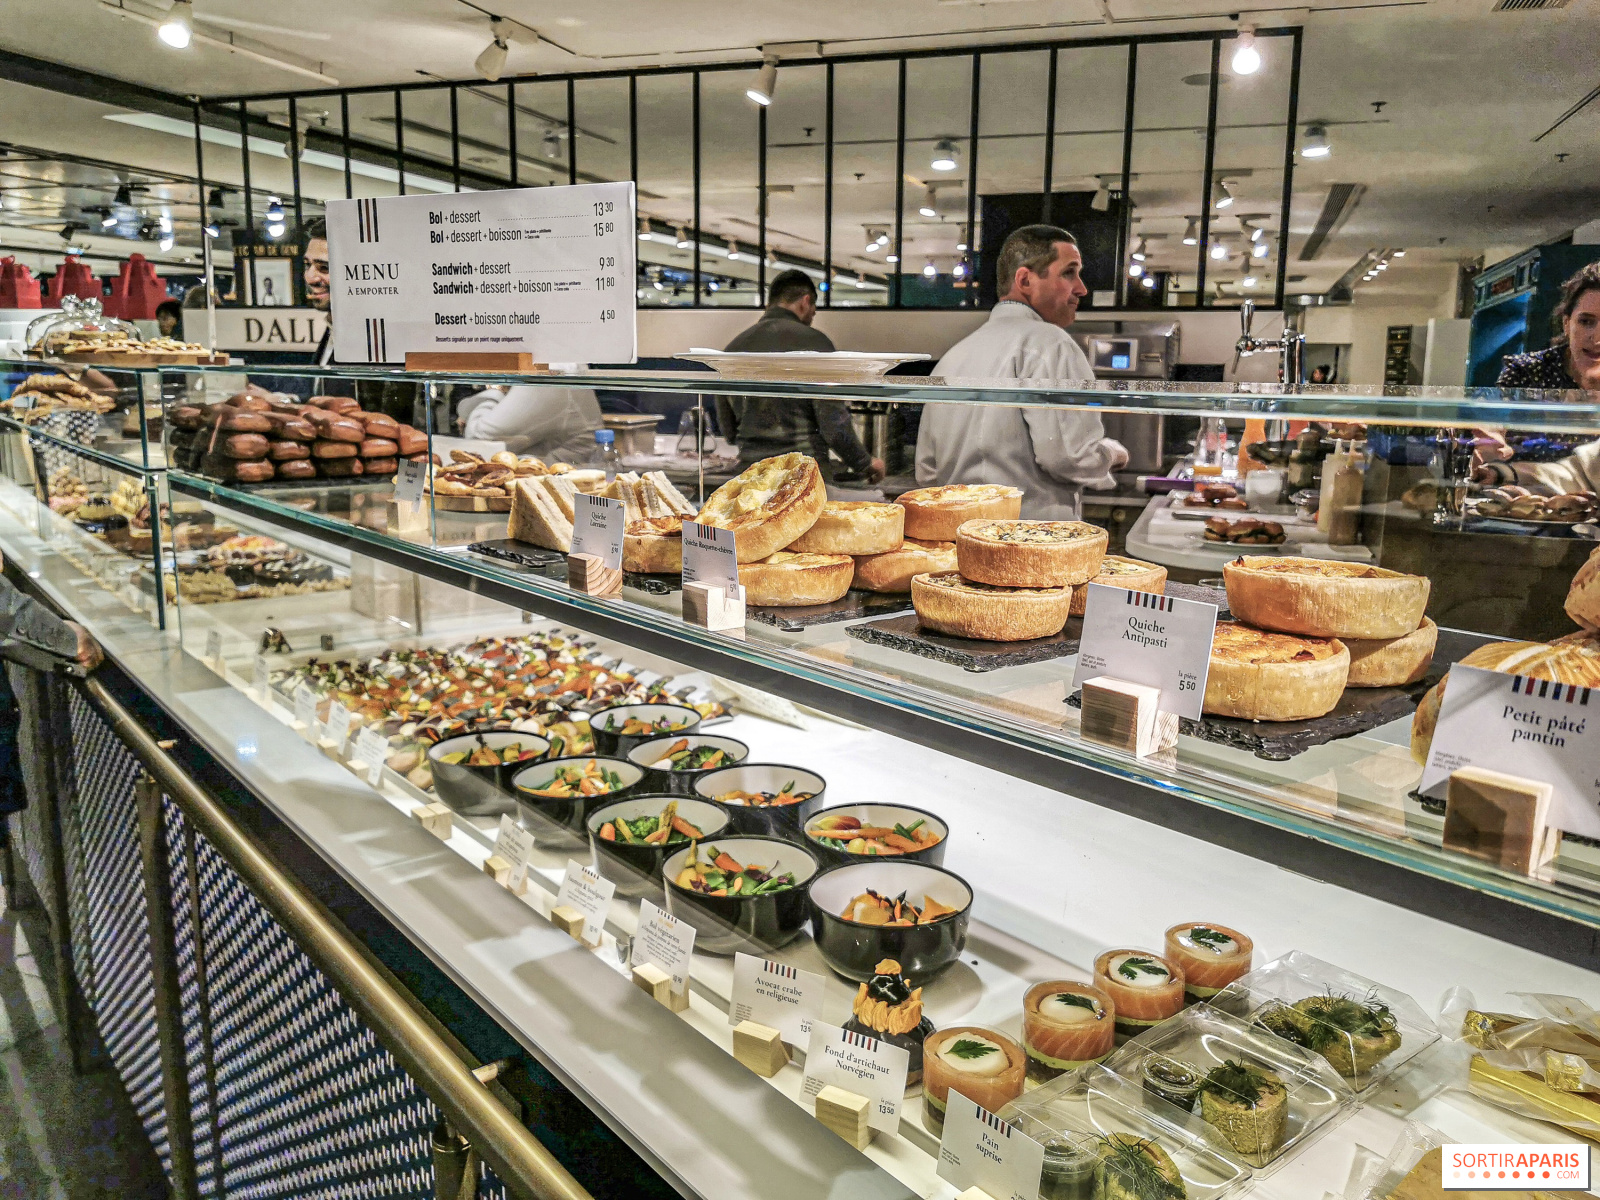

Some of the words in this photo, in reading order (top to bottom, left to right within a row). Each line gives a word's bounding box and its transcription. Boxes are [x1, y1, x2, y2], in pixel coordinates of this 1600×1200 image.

[429, 211, 443, 224] Bol
[450, 210, 481, 224] dessert
[430, 230, 444, 243] Bol
[451, 230, 482, 243] dessert
[488, 228, 522, 241] boisson
[344, 263, 400, 281] MENU
[432, 262, 473, 276] Sandwich
[479, 261, 511, 274] dessert
[348, 286, 354, 295] À
[355, 286, 399, 295] EMPORTER
[433, 281, 473, 294] Sandwich
[480, 281, 511, 293] dessert
[518, 280, 552, 293] boisson
[434, 312, 467, 325] Dessert
[474, 312, 506, 325] boisson
[508, 311, 540, 324] chaude
[592, 512, 606, 521] Quiche
[684, 538, 698, 547] Quiche
[1128, 616, 1165, 636] Quiche
[1121, 629, 1168, 648] Antipasti
[1502, 705, 1542, 726] Petit
[1546, 716, 1586, 734] pâté
[1511, 729, 1566, 749] pantin
[755, 977, 780, 990] Avocat
[782, 985, 802, 997] crabe
[756, 987, 764, 995] en
[766, 989, 799, 1005] religieuse
[824, 1045, 844, 1059] Fond
[846, 1053, 890, 1075] d'artichaut
[836, 1060, 875, 1080] Norvégien
[982, 1132, 999, 1151] Pain
[976, 1143, 1003, 1164] suprise
